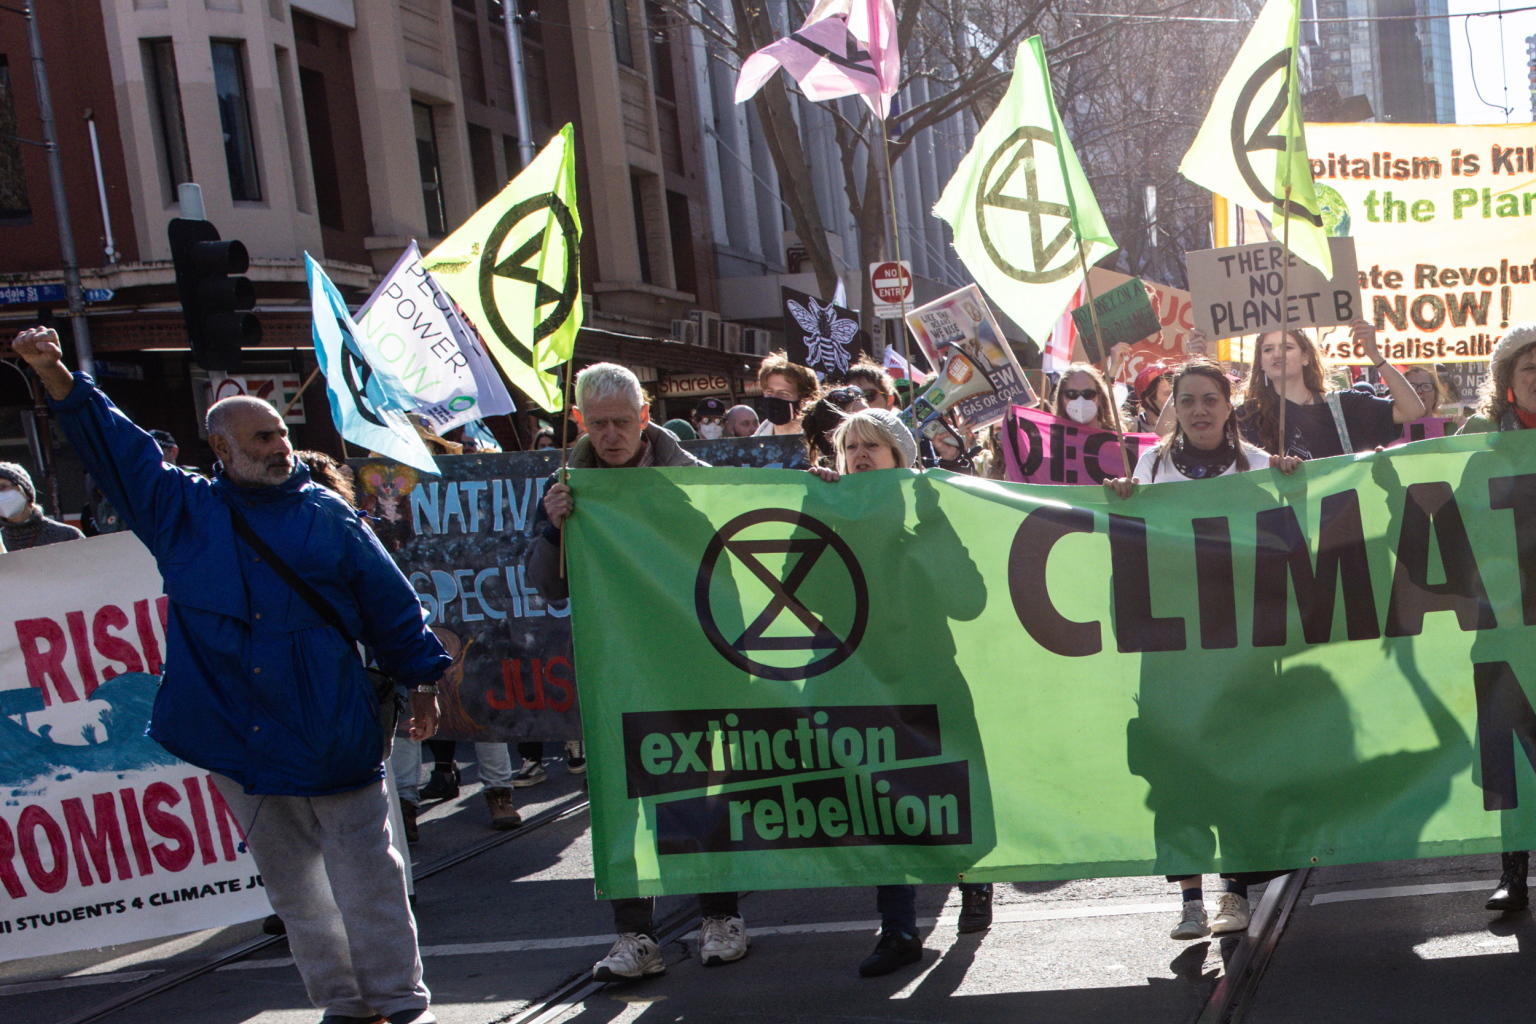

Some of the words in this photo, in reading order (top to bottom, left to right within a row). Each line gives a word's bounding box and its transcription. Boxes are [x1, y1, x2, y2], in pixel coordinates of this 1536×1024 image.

[1451, 149, 1480, 176] is
[1363, 190, 1436, 223] the
[884, 268, 898, 278] NO
[1250, 271, 1285, 299] NO
[879, 287, 907, 297] ENTRY
[1210, 292, 1321, 335] PLANET
[1333, 290, 1353, 321] B
[1372, 286, 1512, 333] NOW!
[987, 365, 1016, 390] EW
[962, 400, 983, 417] GAS
[983, 393, 998, 408] OR
[998, 384, 1024, 402] COAL
[14, 595, 170, 708] RISI
[640, 711, 897, 776] extinction
[729, 770, 960, 842] rebellion
[17, 899, 127, 931] STUDENTS
[131, 896, 144, 909] 4
[148, 878, 242, 907] CLIMATE
